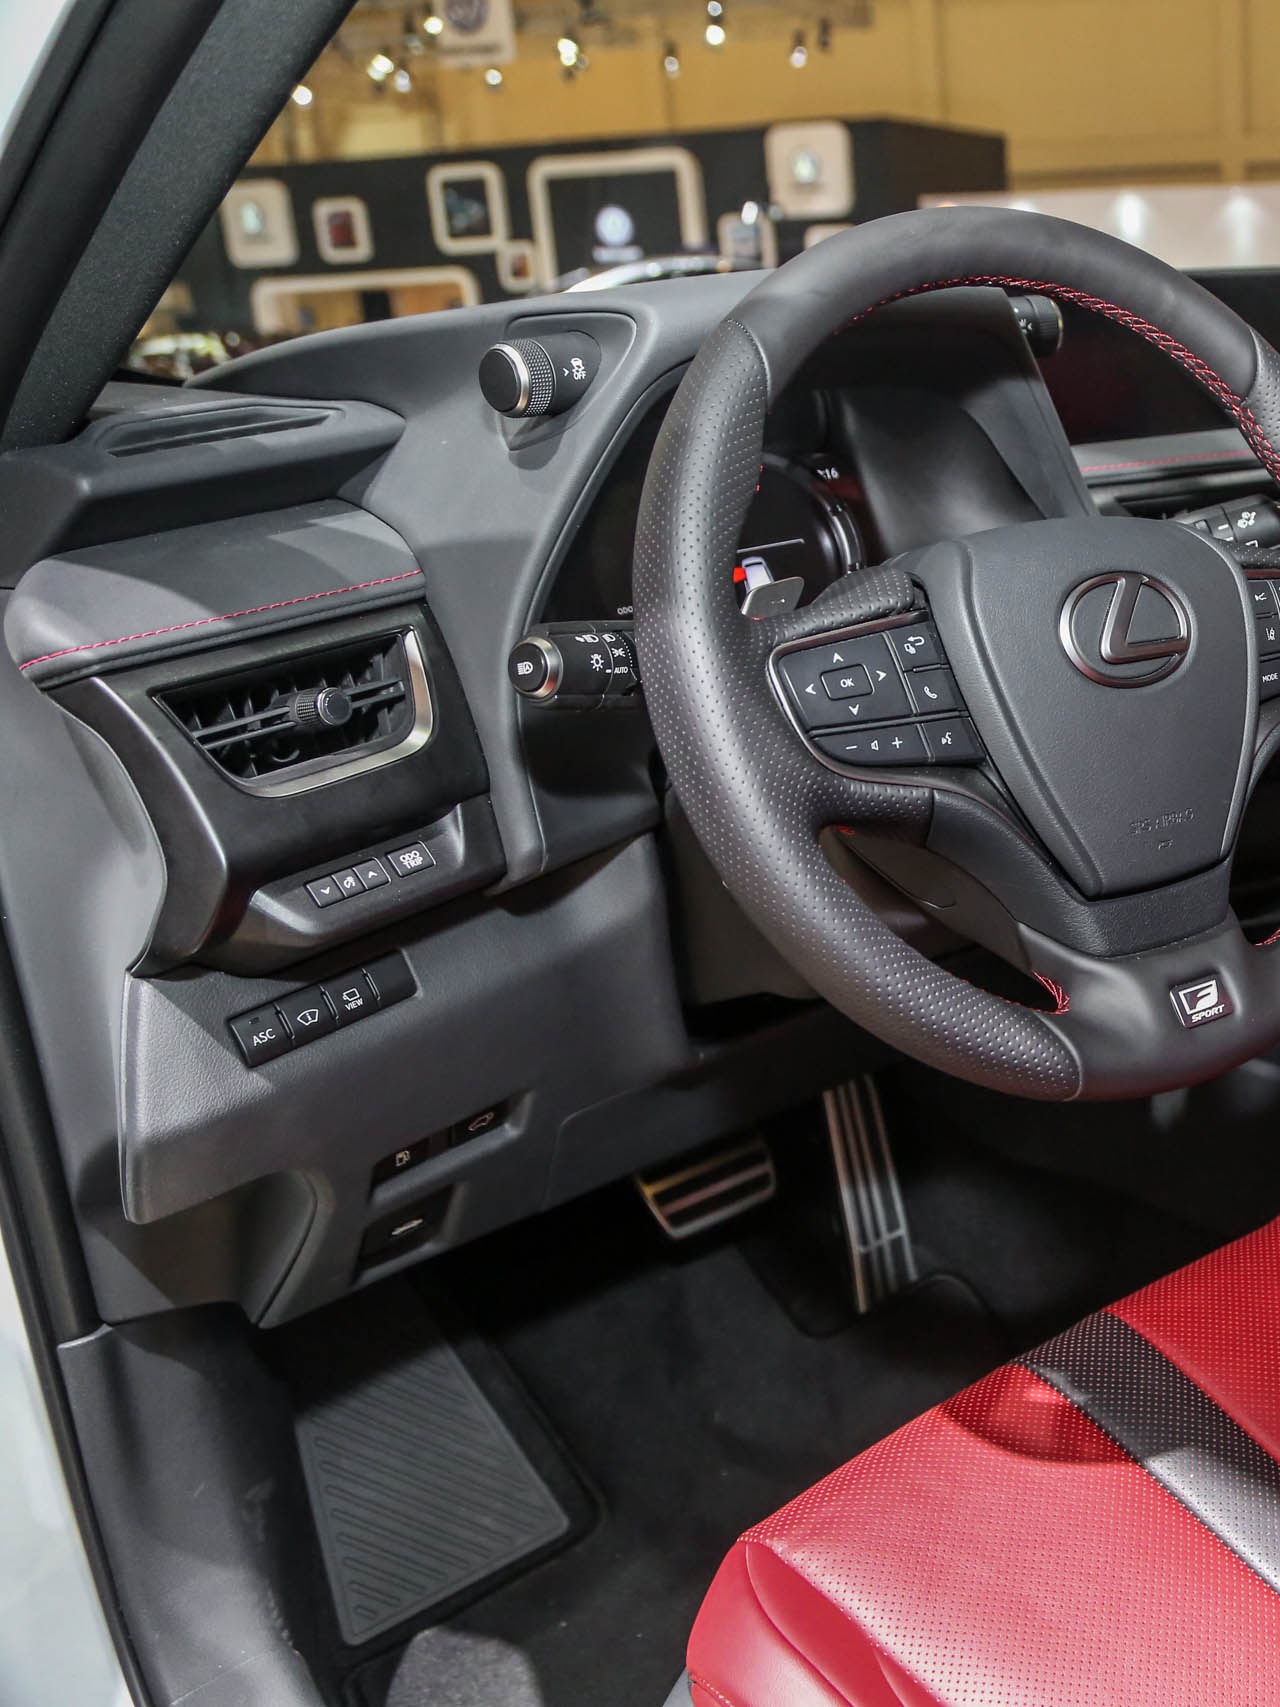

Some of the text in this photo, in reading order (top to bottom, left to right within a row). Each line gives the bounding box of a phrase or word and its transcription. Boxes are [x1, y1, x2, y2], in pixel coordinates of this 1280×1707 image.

[574, 371, 586, 380] OFF
[617, 606, 633, 615] ODO
[614, 666, 629, 674] AUTO
[840, 677, 855, 688] OK
[1262, 672, 1279, 682] MODE
[400, 850, 420, 863] ODO
[402, 856, 423, 869] TRIP
[344, 998, 364, 1011] VIEW
[1191, 1003, 1225, 1023] SPORT
[252, 1028, 276, 1046] ASC
